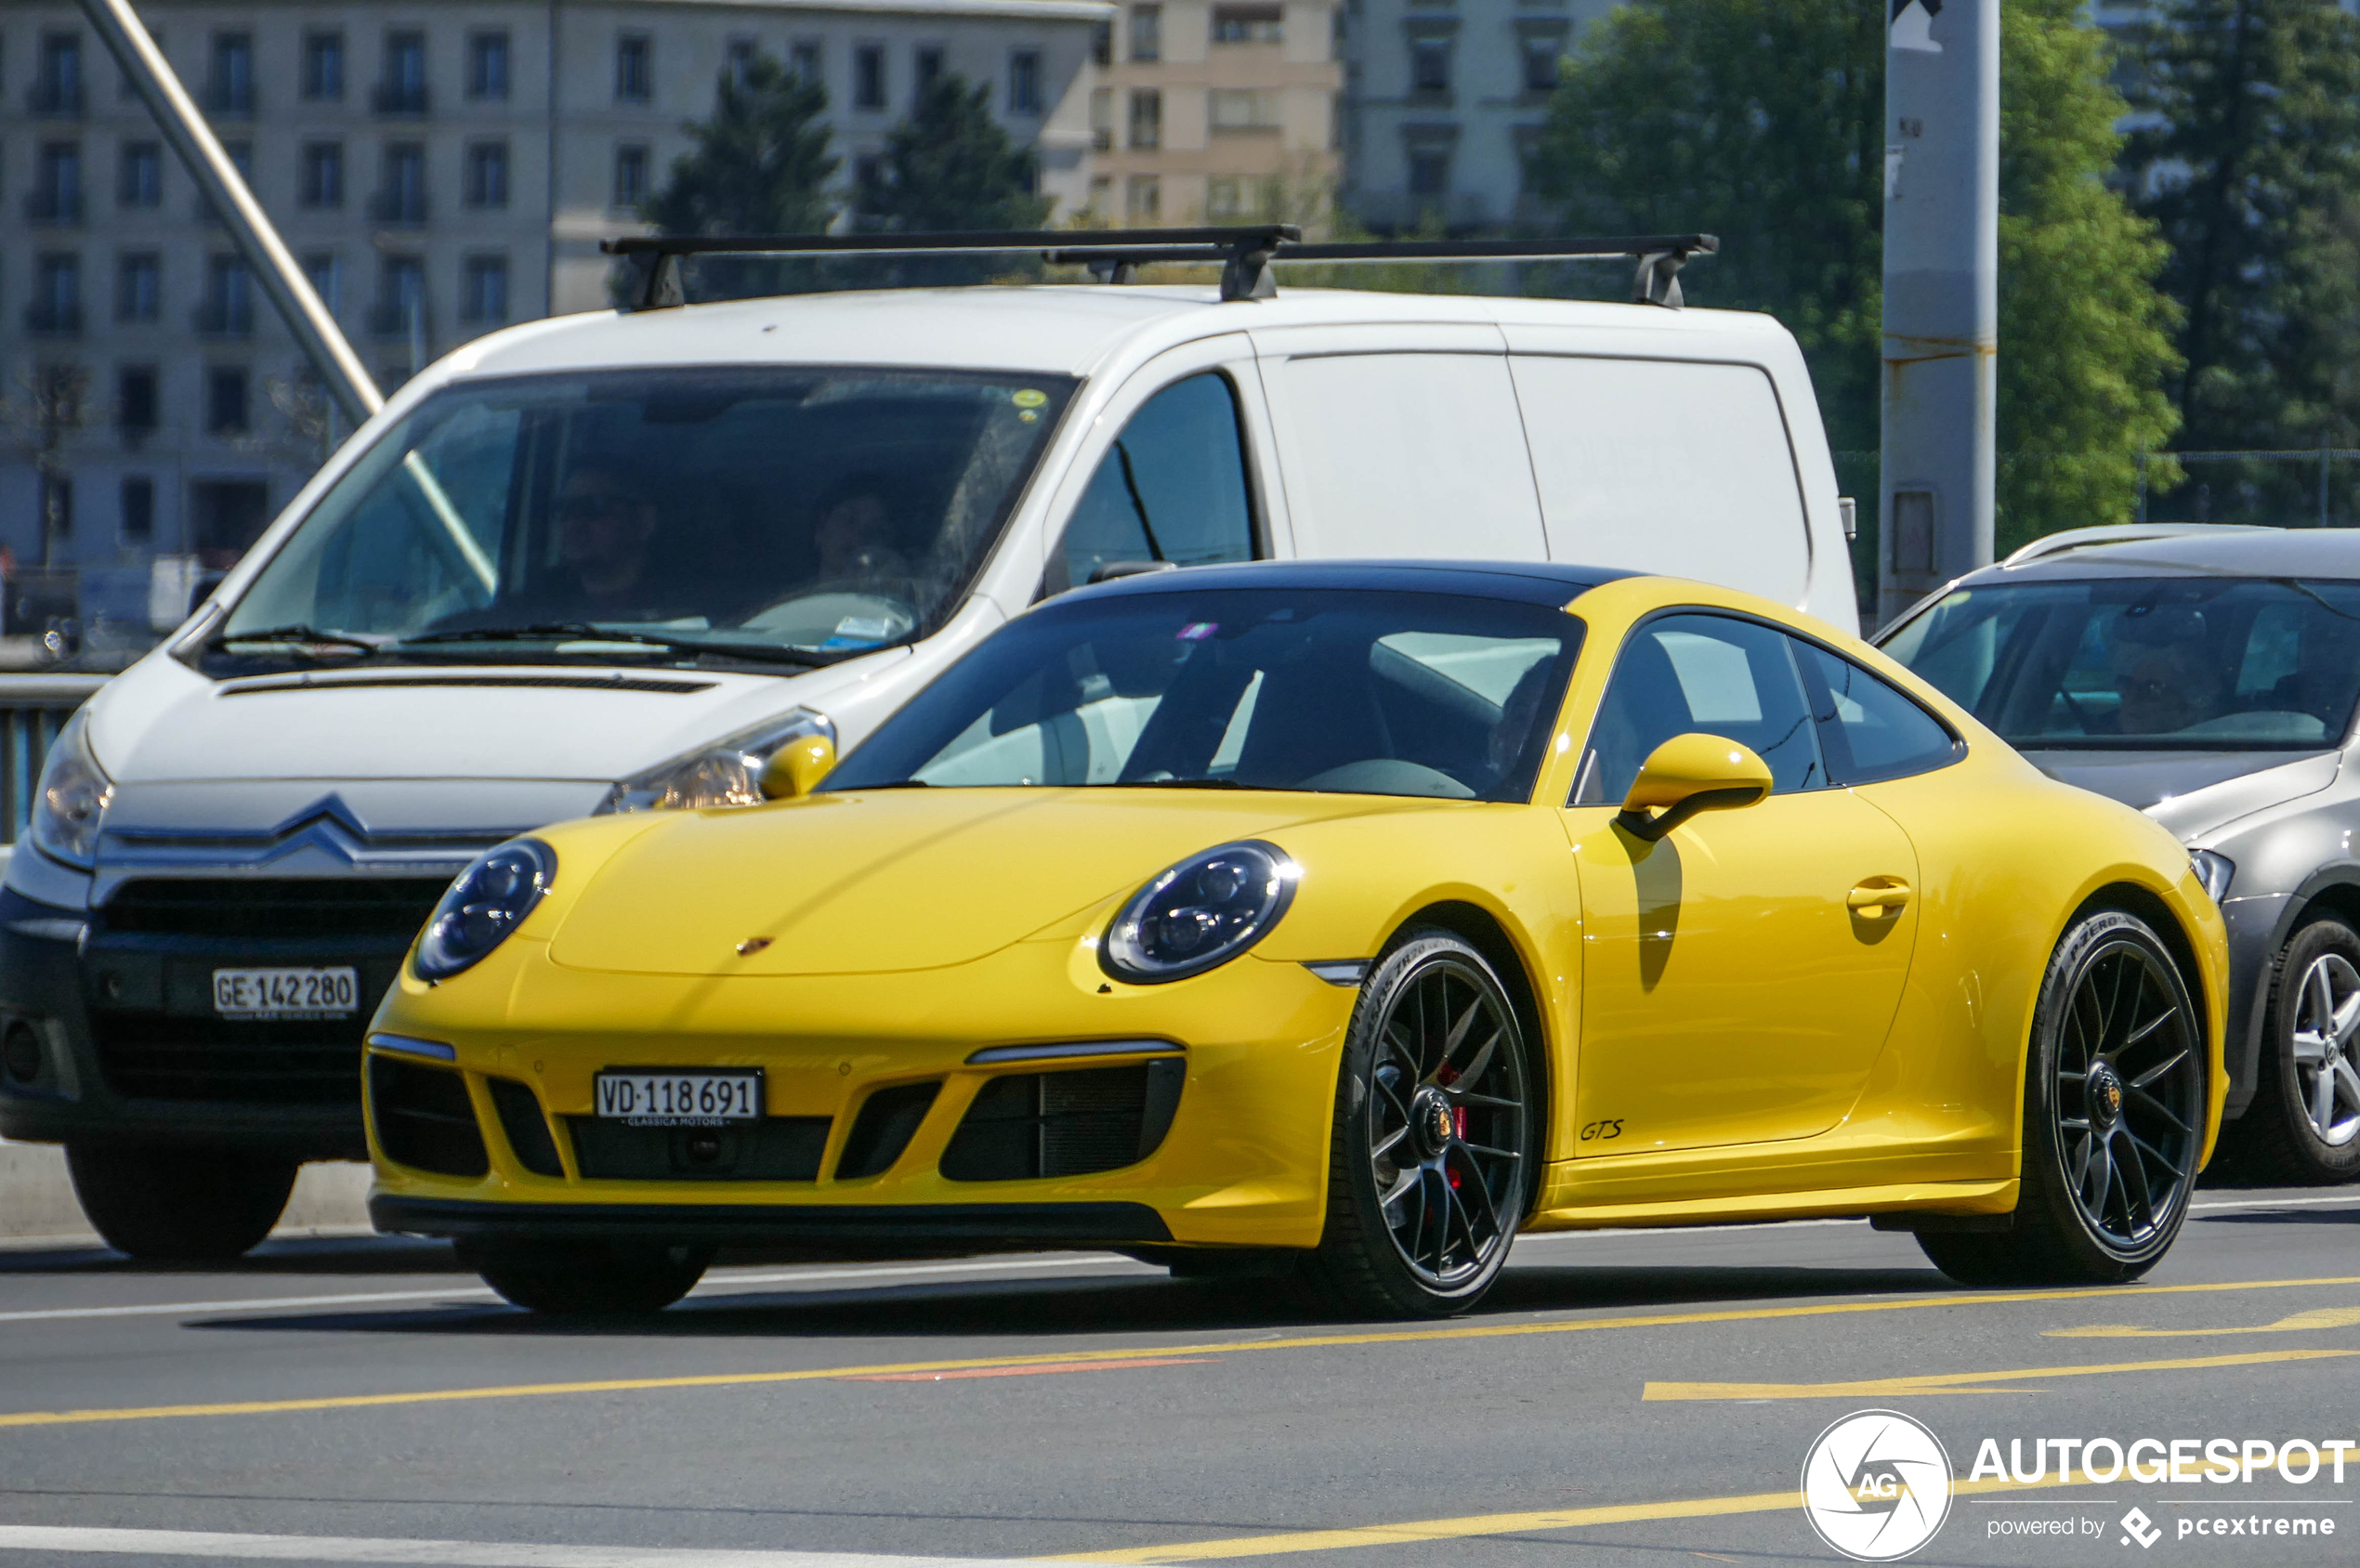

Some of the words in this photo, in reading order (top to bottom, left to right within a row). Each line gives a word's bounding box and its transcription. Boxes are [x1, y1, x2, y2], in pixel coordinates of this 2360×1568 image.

[627, 1117, 676, 1127] CLASSICA
[680, 1117, 724, 1127] MOTORS
[1580, 1118, 1625, 1141] GTS
